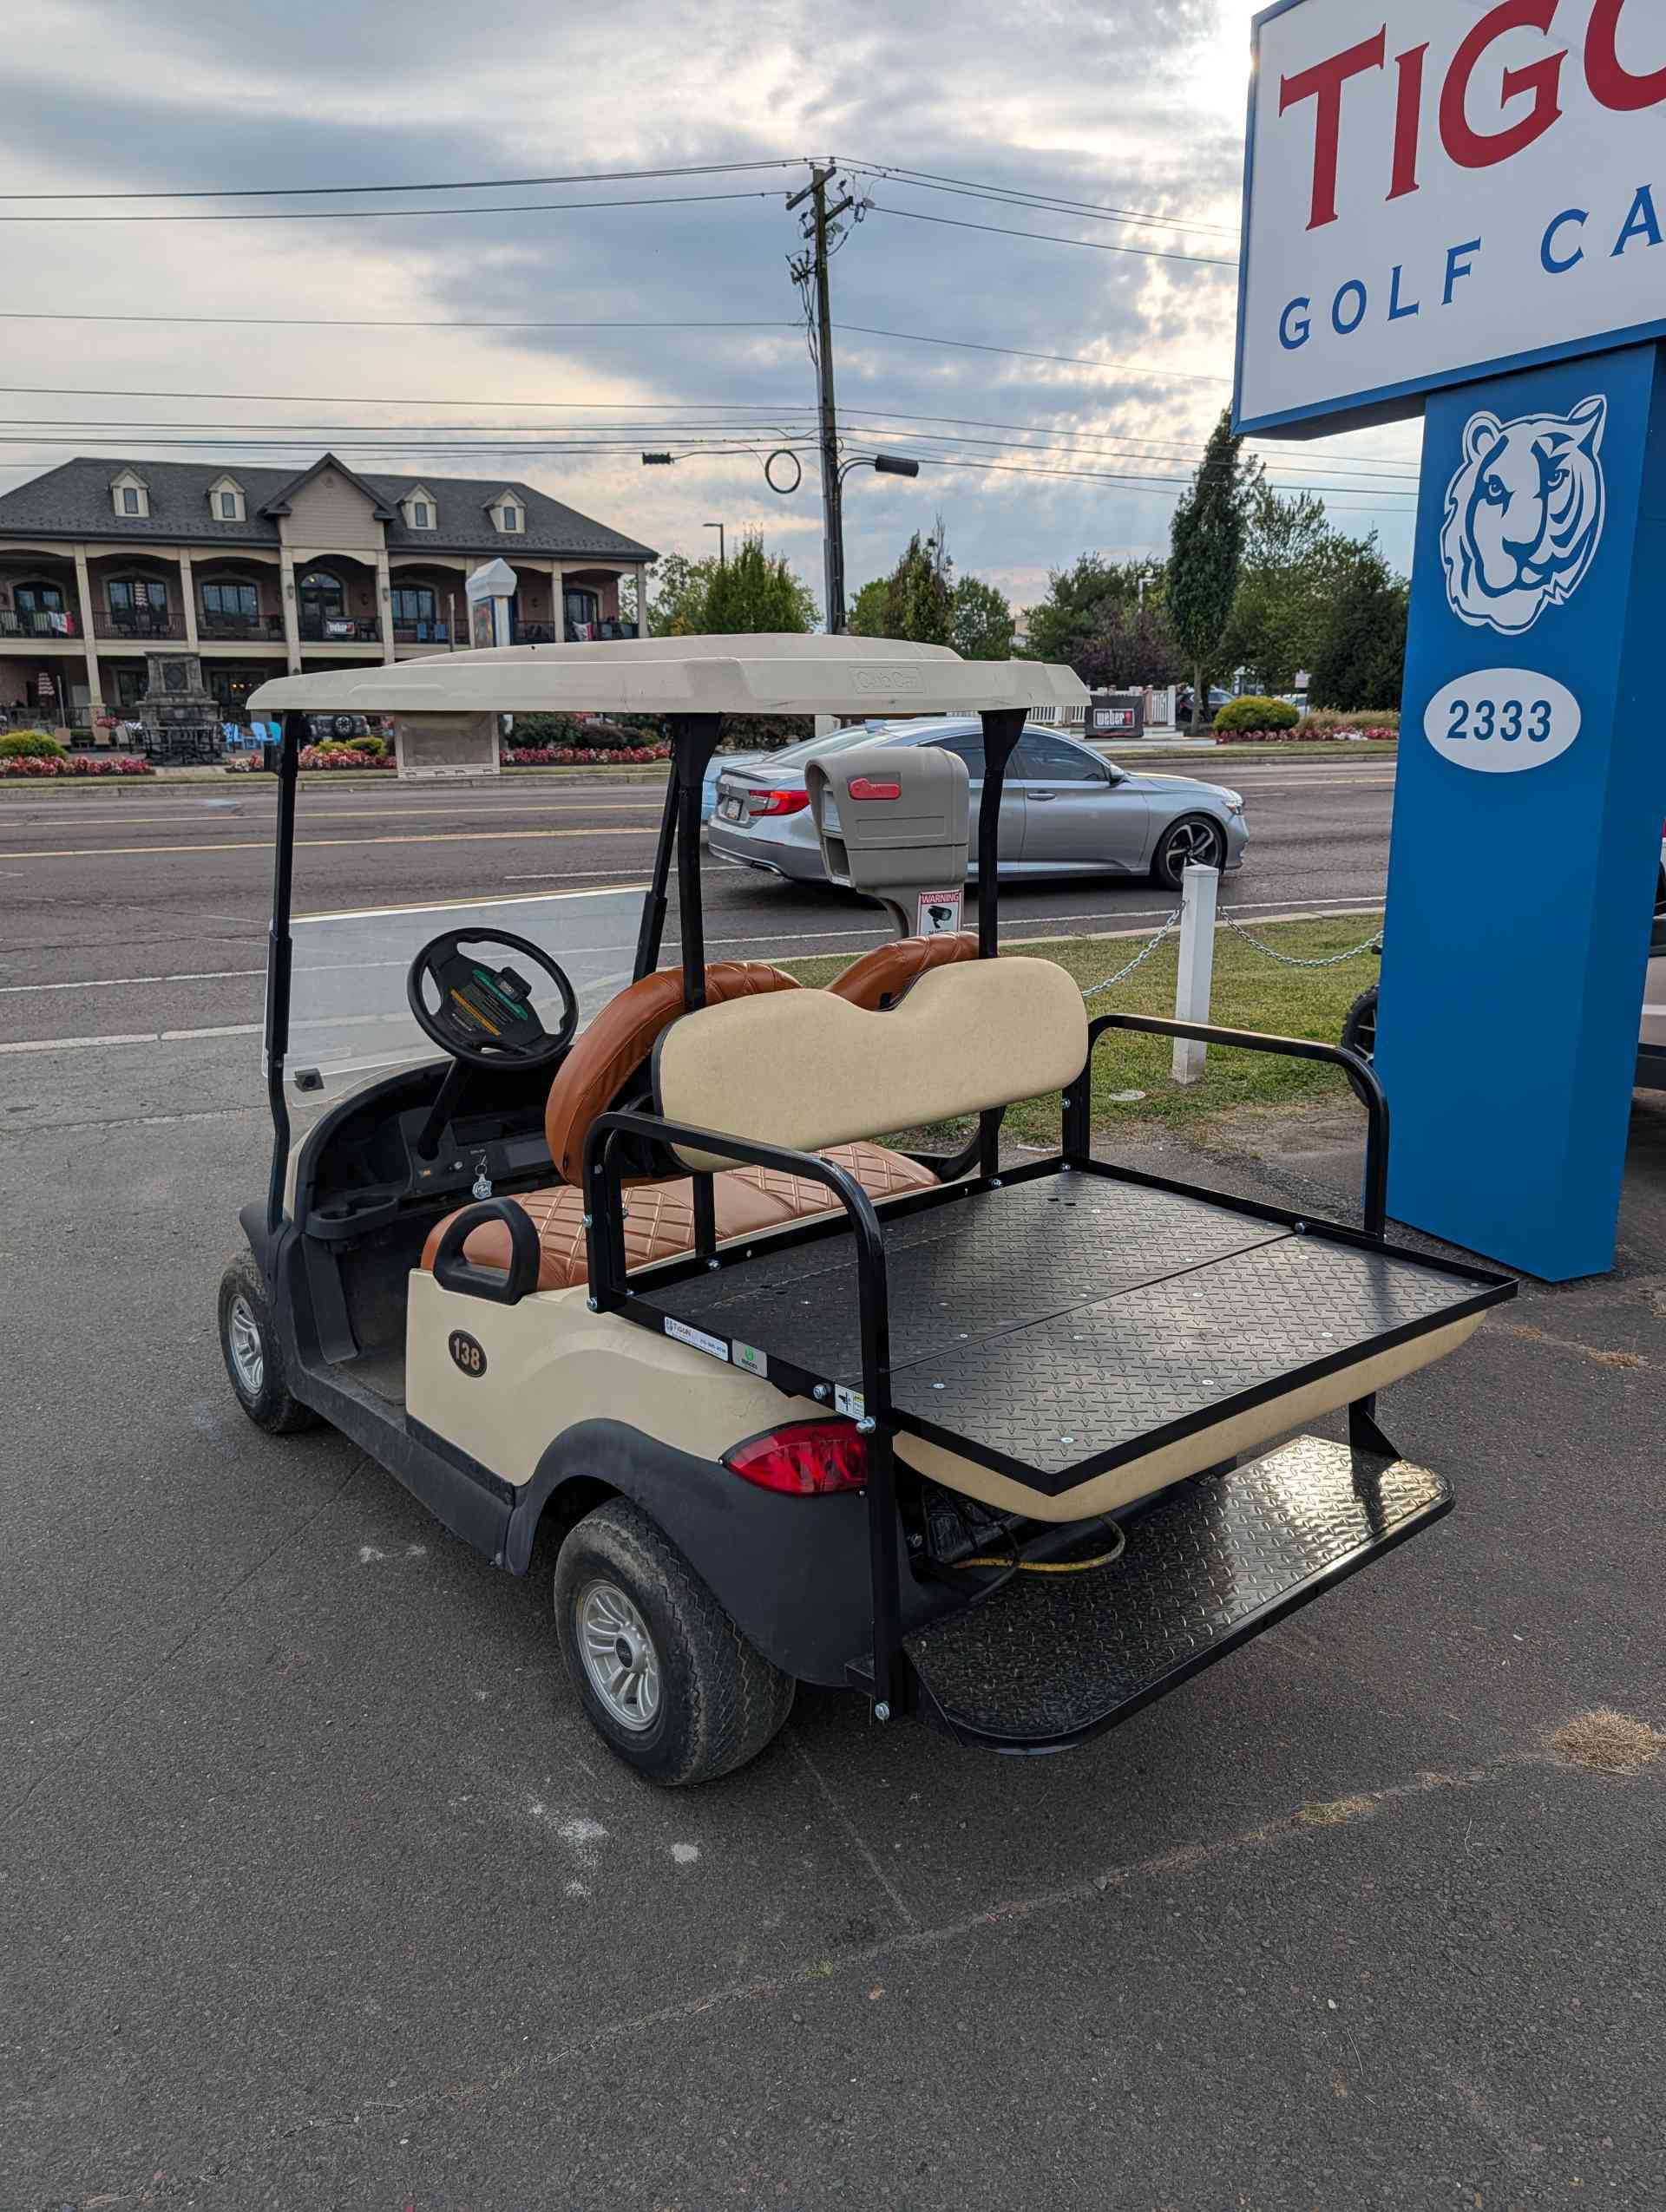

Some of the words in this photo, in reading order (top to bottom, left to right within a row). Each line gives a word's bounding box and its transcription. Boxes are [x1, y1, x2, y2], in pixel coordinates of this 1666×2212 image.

[1279, 237, 1481, 350] GOLF
[1446, 699, 1551, 742] 2333
[922, 893, 959, 903] WARNING
[454, 1338, 480, 1371] 138
